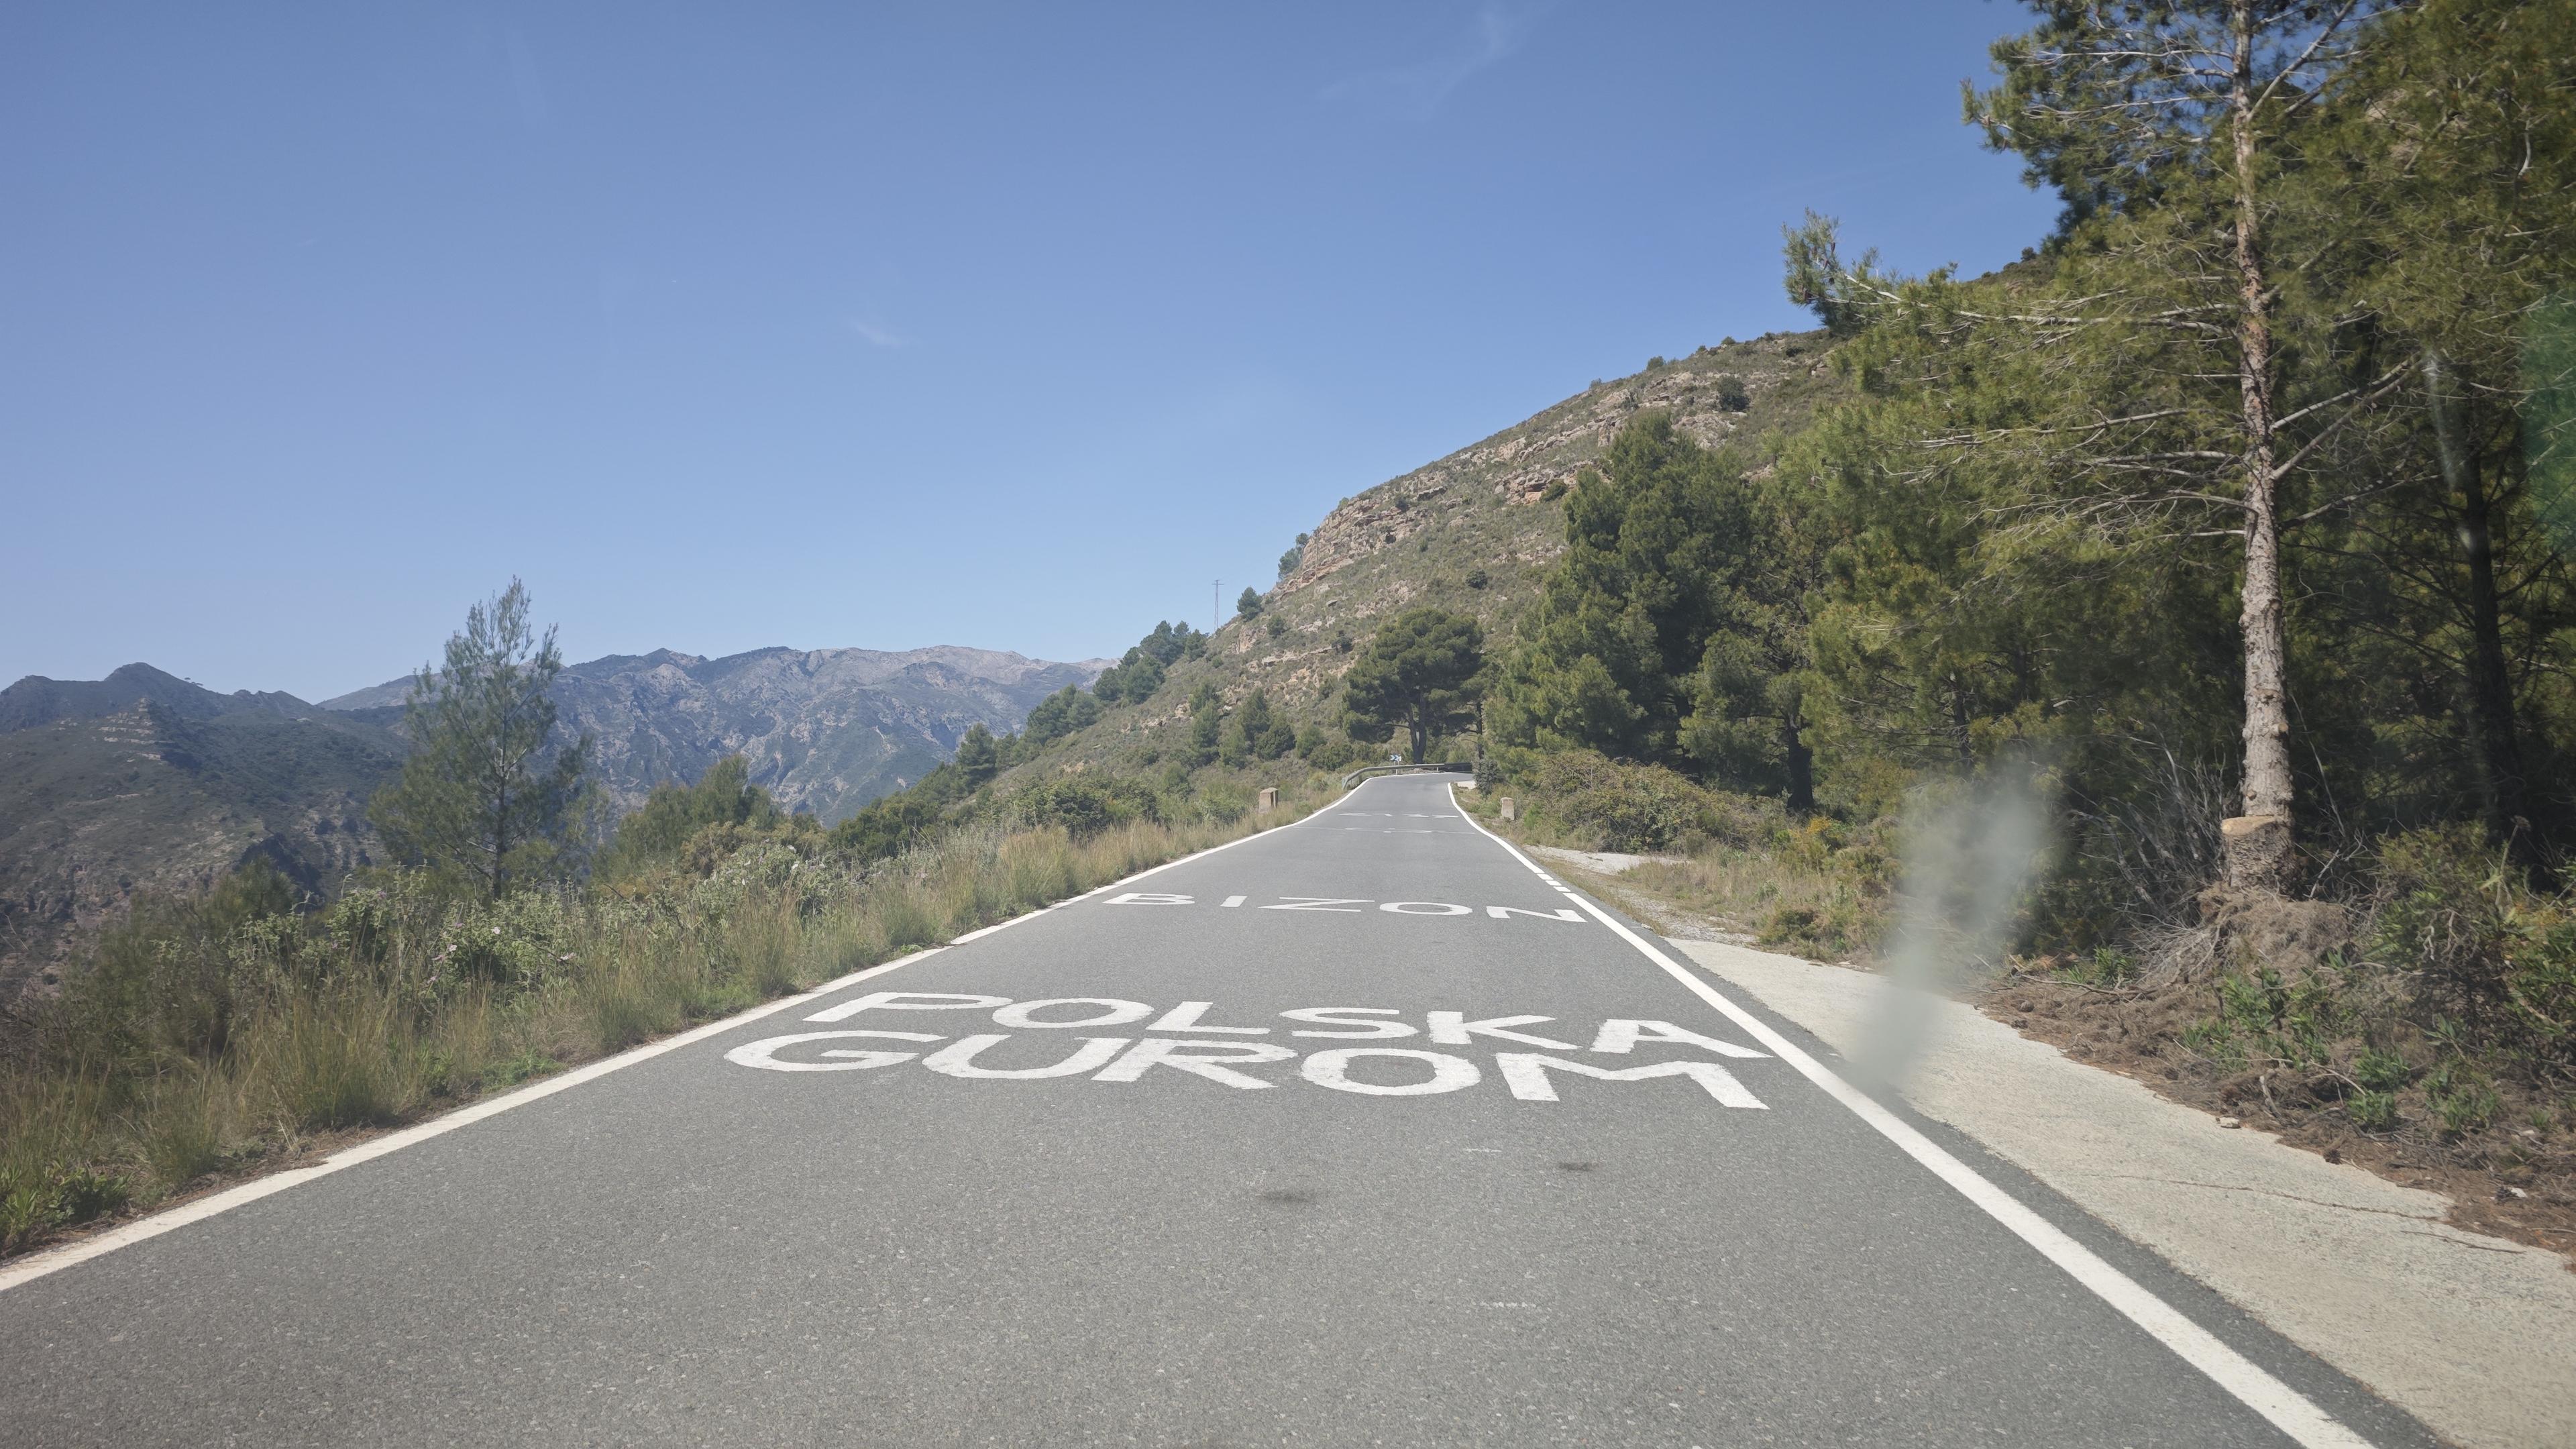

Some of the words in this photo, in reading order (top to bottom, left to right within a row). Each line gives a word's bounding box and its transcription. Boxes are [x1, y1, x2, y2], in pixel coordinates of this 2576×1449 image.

[1100, 892, 1589, 924] BIZON
[800, 991, 1774, 1059] POLSKA
[722, 1029, 1771, 1111] GUROM
